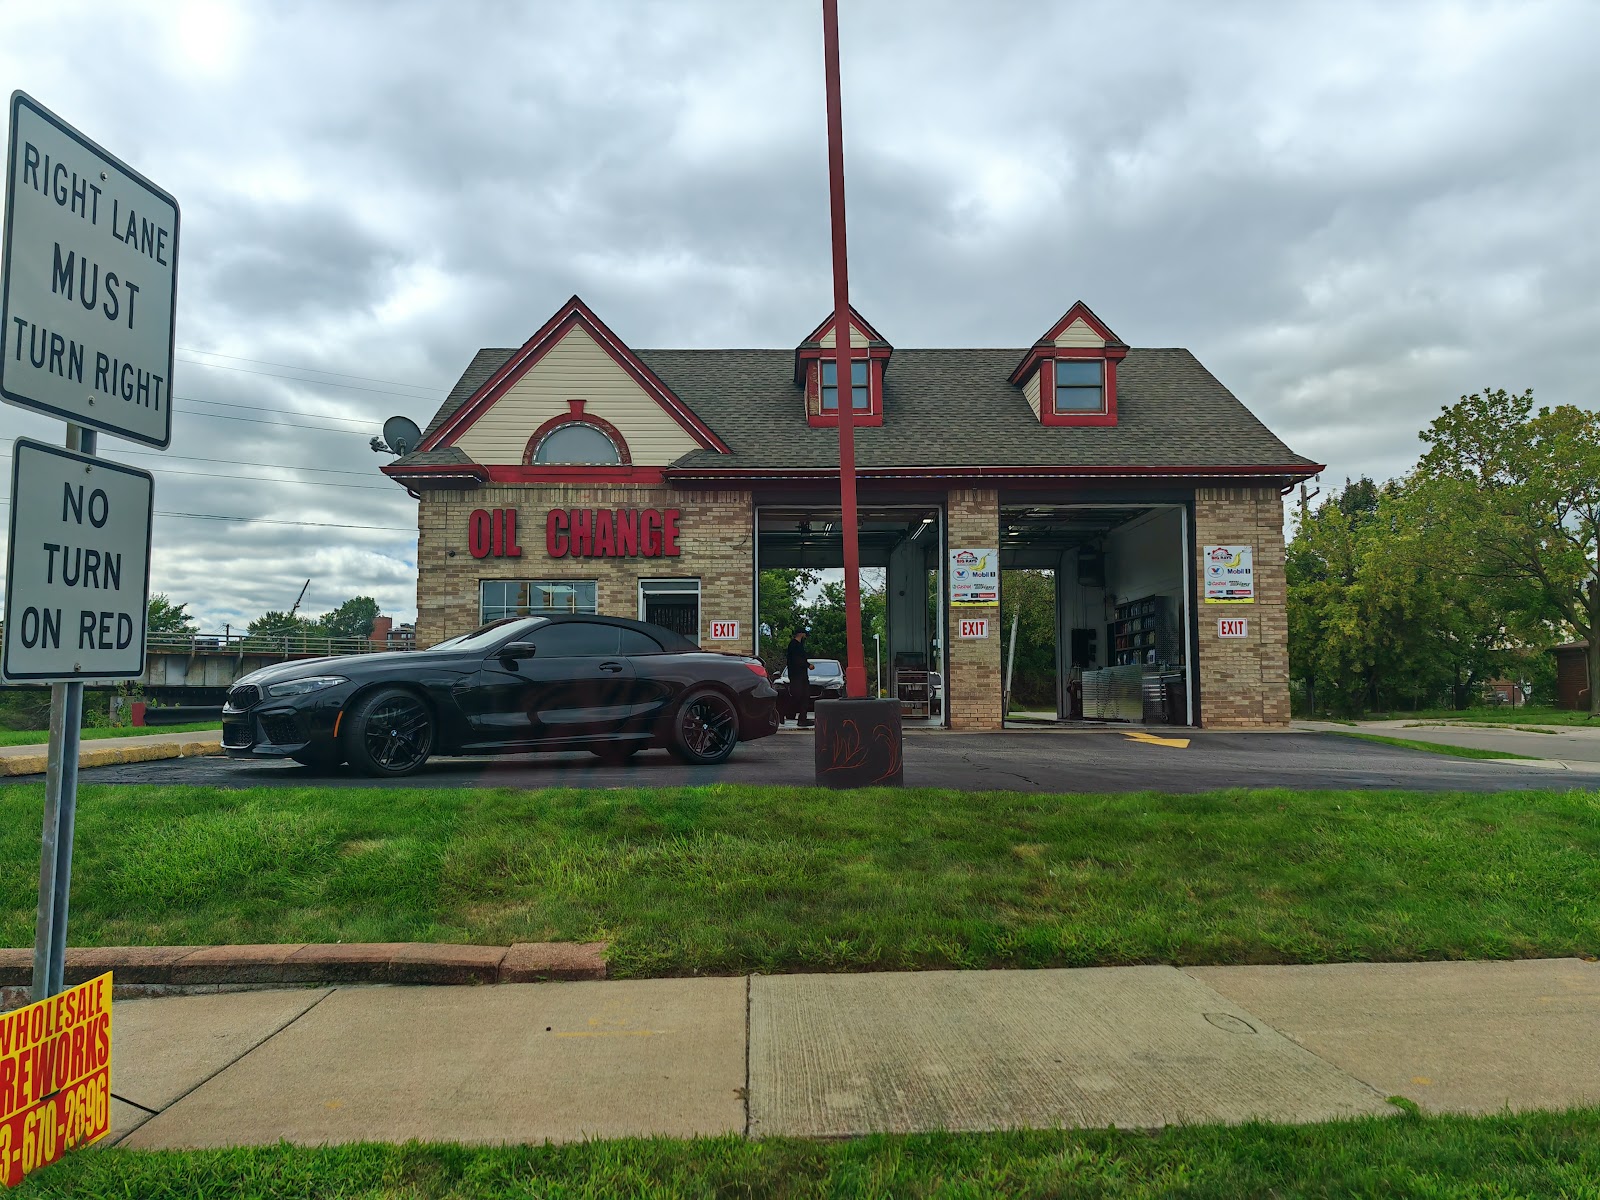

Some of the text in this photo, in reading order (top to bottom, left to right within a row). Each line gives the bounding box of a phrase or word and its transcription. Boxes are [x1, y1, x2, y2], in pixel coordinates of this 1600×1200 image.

[23, 141, 168, 267] RIGHT LANE
[51, 241, 140, 330] MUST
[13, 316, 164, 411] TURN RIGHT
[62, 481, 109, 529] NO
[468, 508, 681, 559] OIL CHANGE
[43, 542, 121, 591] TURN
[21, 606, 133, 650] ON RED
[713, 623, 736, 637] EXIT
[962, 621, 985, 636] EXIT
[1221, 621, 1243, 635] EXIT
